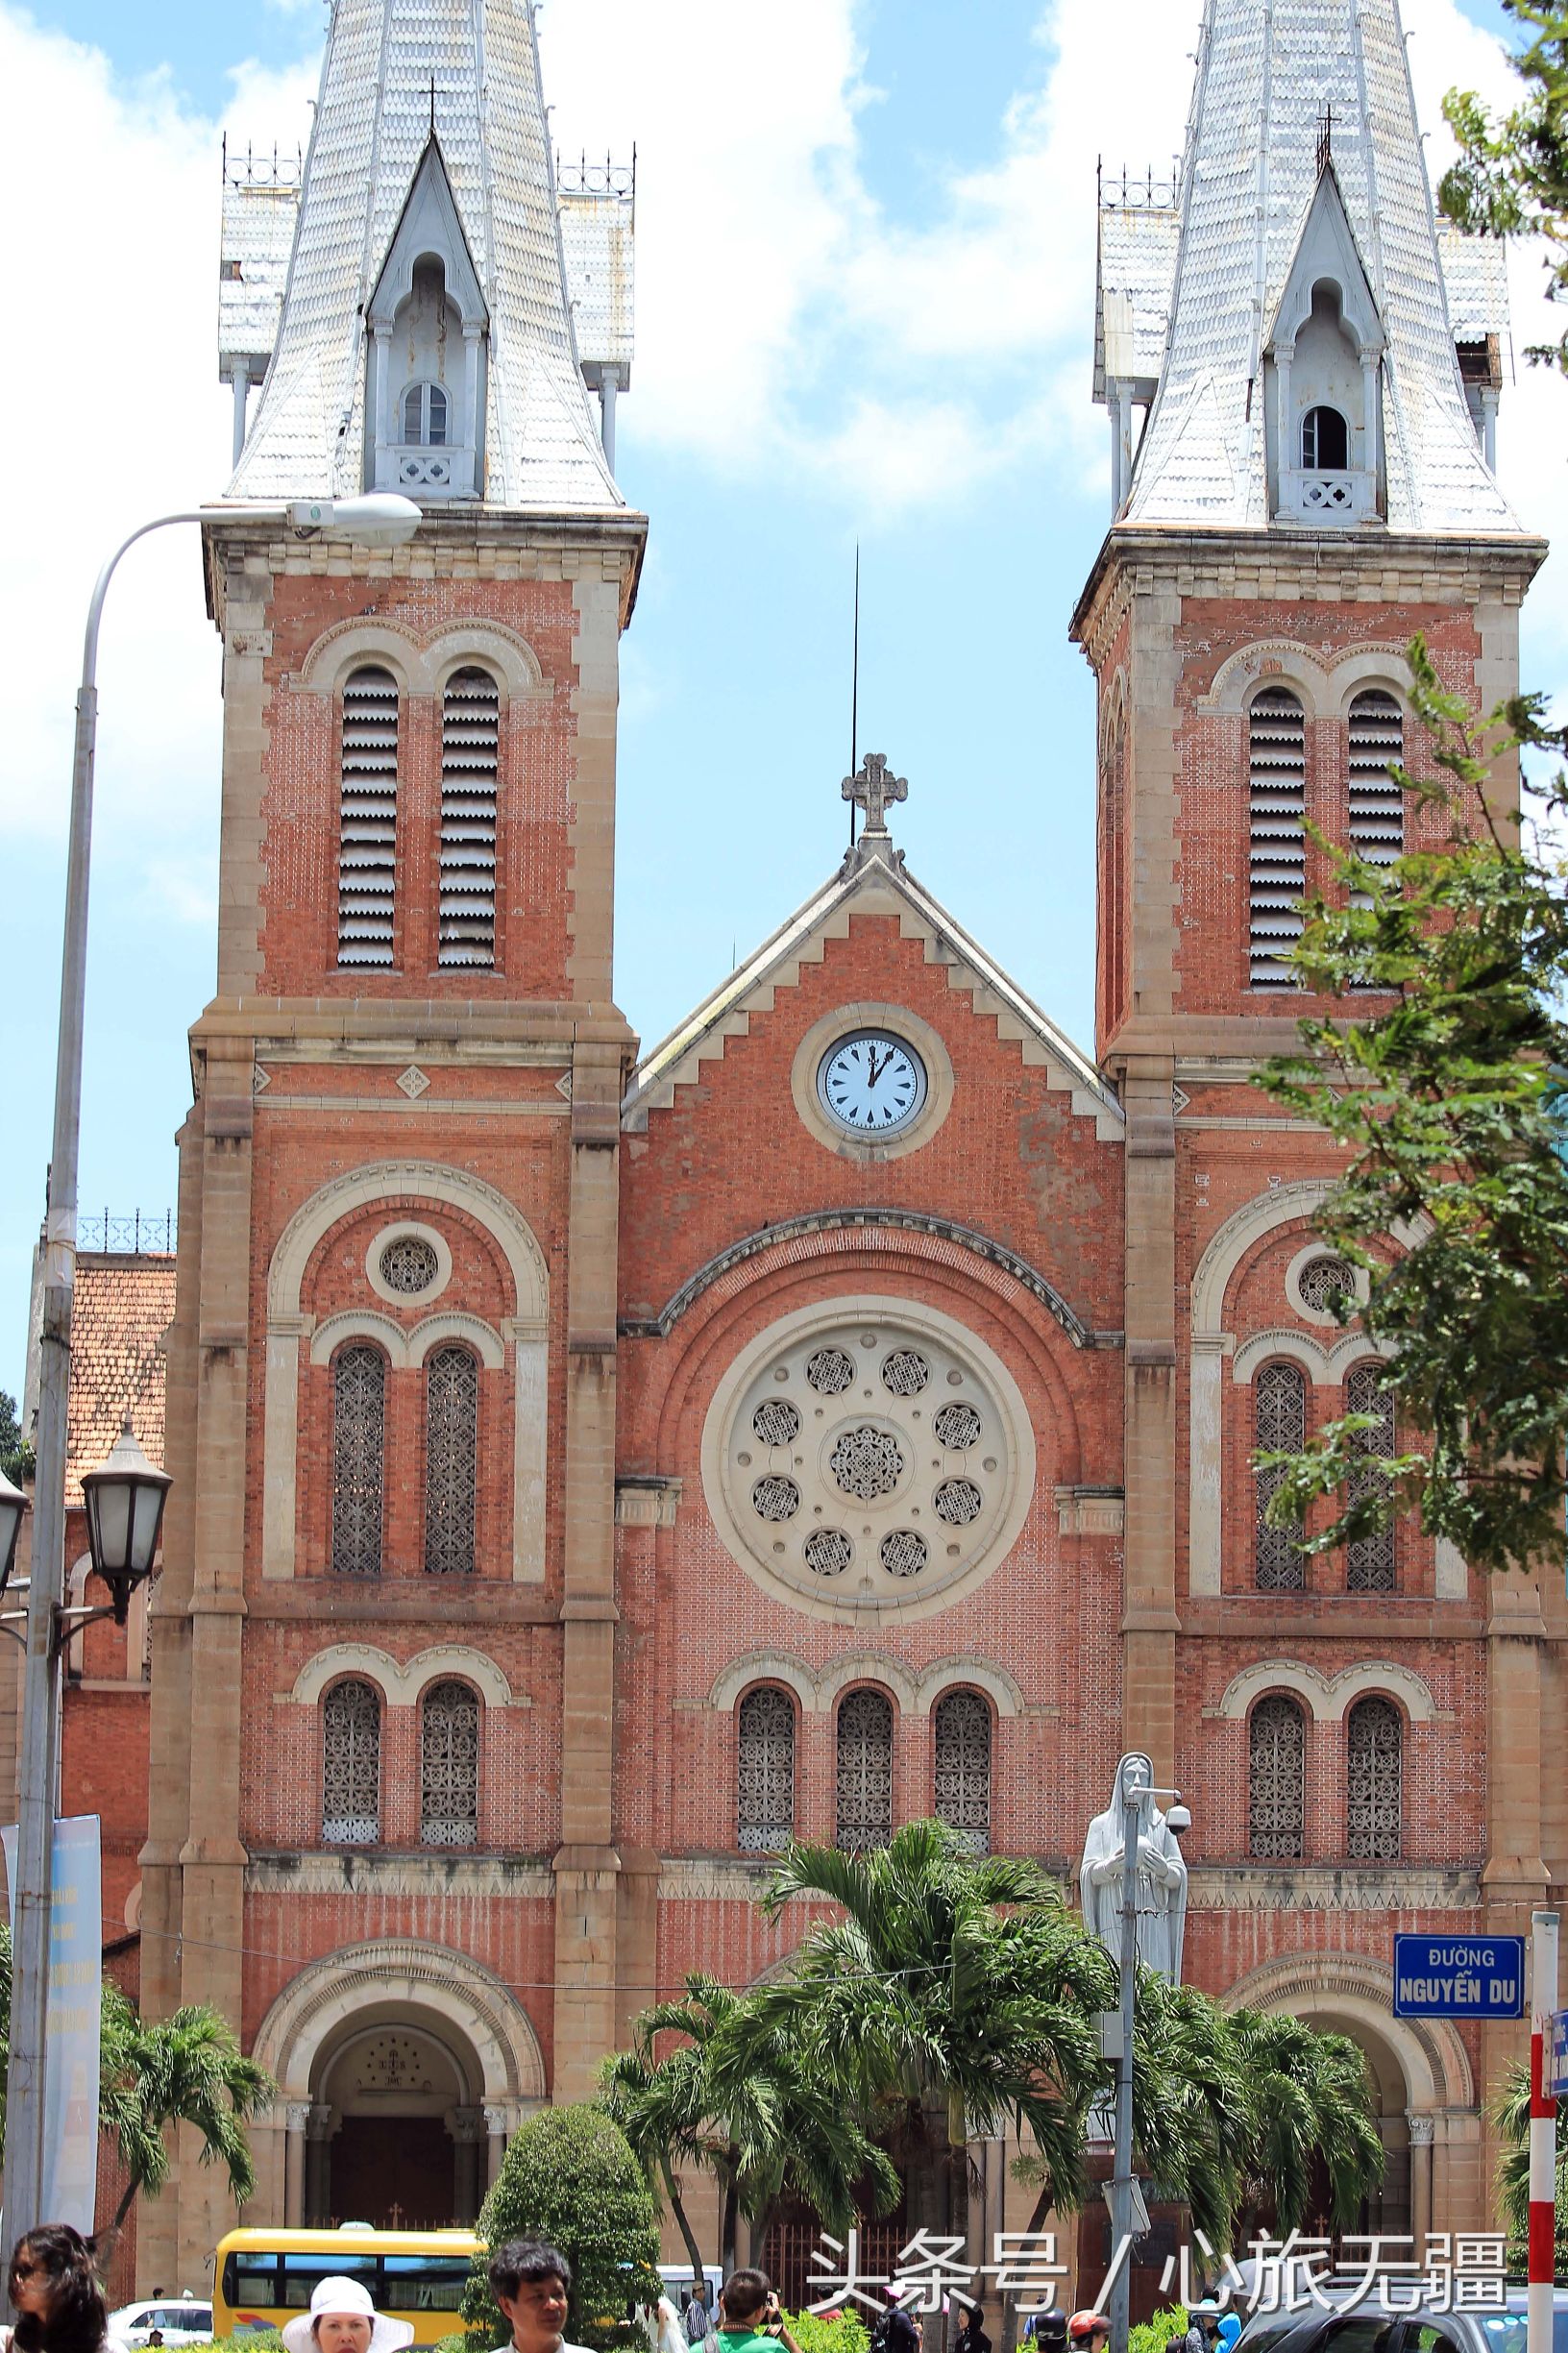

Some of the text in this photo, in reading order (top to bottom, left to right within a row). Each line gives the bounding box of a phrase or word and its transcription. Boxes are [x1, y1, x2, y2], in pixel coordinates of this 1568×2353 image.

[1429, 1945, 1495, 1967] ĐƯỜNG
[1400, 1971, 1515, 2003] NGUYỄN DU
